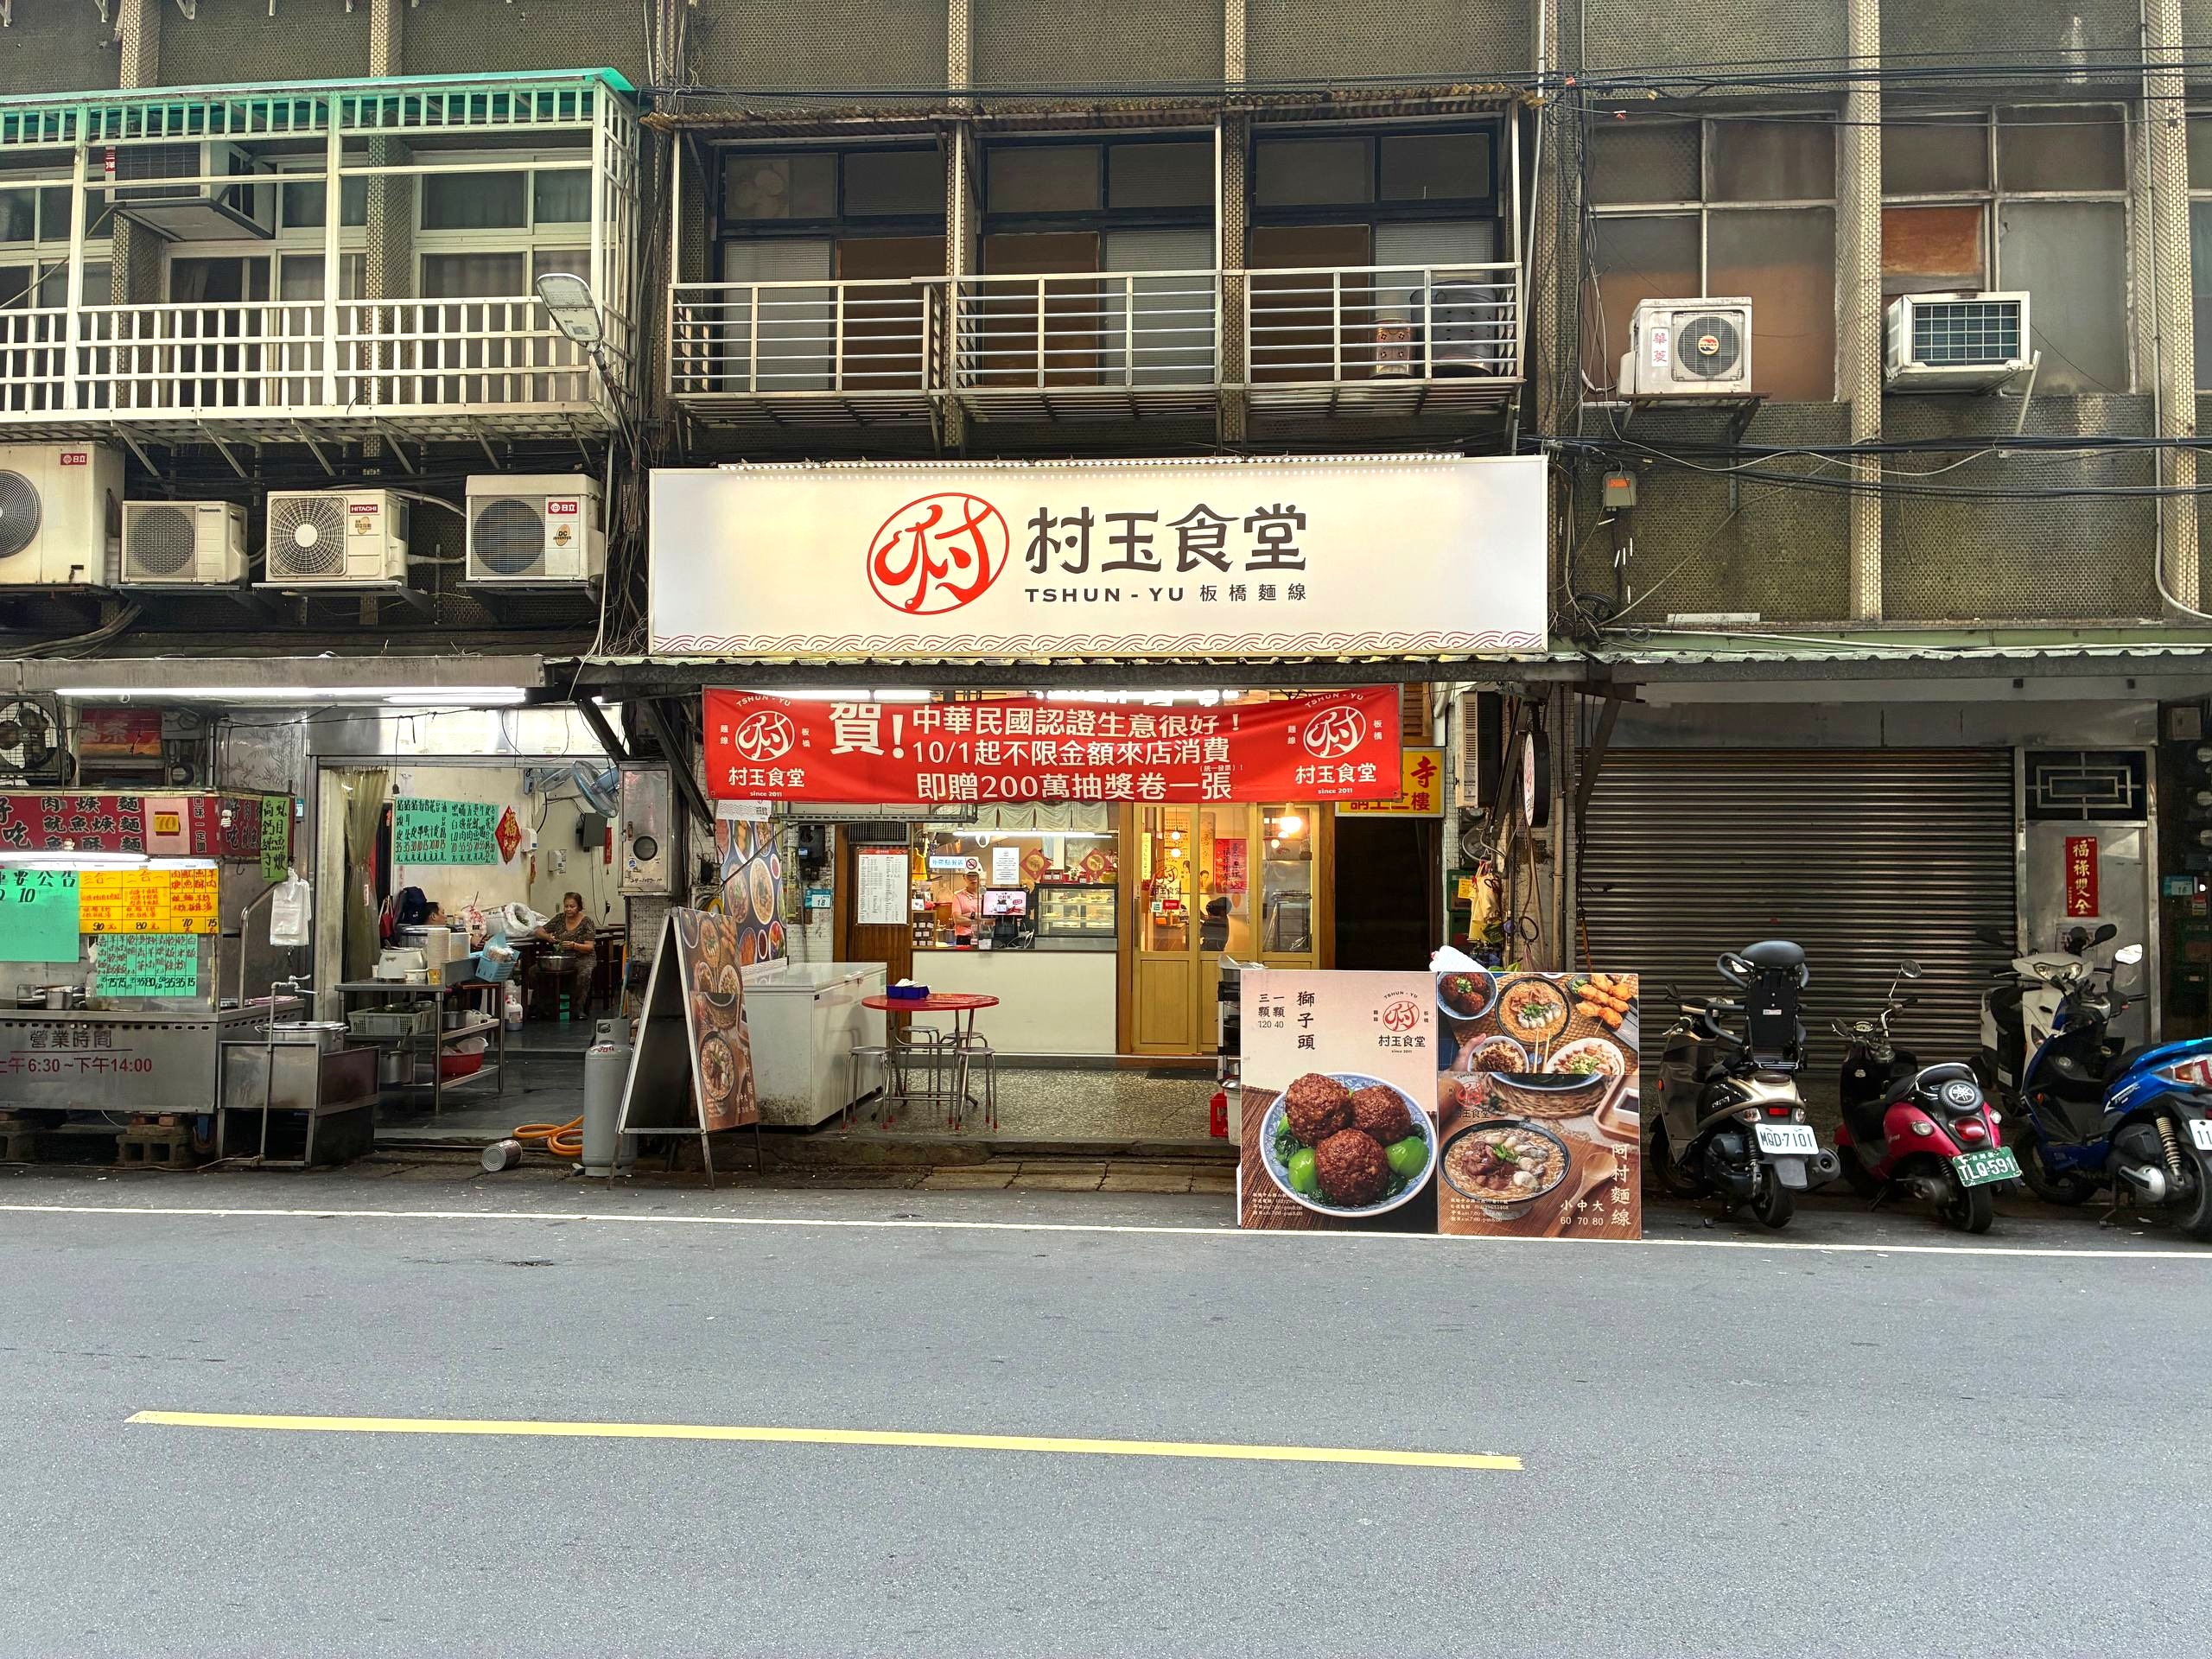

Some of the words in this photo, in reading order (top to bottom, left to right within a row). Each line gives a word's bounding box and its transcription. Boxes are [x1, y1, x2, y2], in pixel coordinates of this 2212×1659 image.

[1653, 333, 1667, 362] 華菱
[1025, 503, 1306, 574] 村玉食堂
[1025, 588, 1121, 602] TSHUN
[1151, 588, 1184, 602] YU
[1198, 582, 1306, 602] 板橋麵線
[912, 737, 1230, 766] 10/1起不限金額來店消費
[728, 766, 805, 787] 村玉食堂
[1295, 762, 1376, 785] 村玉食堂
[1410, 755, 1438, 788] 寺
[917, 771, 1232, 802] 即贈200萬抽獎卷一張
[156, 816, 176, 830] 70
[84, 872, 117, 885] 三合一
[127, 870, 164, 883] 二合一
[2073, 840, 2092, 915] 福祿雙全
[18, 888, 35, 903] 10
[92, 922, 105, 931] 90
[181, 918, 193, 927] 70
[207, 918, 218, 927] 75
[1296, 991, 1315, 1050] 獅子頭
[30, 1030, 112, 1048] 營業時間
[1378, 1035, 1426, 1048] 村玉食堂
[1759, 1131, 1813, 1148] MQD-7101
[1958, 1155, 2016, 1182] TLQ-591
[1611, 1143, 1631, 1227] 阿村麵線
[1560, 1199, 1573, 1211] 小
[1577, 1199, 1587, 1212] 中
[1592, 1199, 1605, 1212] 大
[1577, 1217, 1589, 1225] 70
[1592, 1217, 1604, 1226] 80
